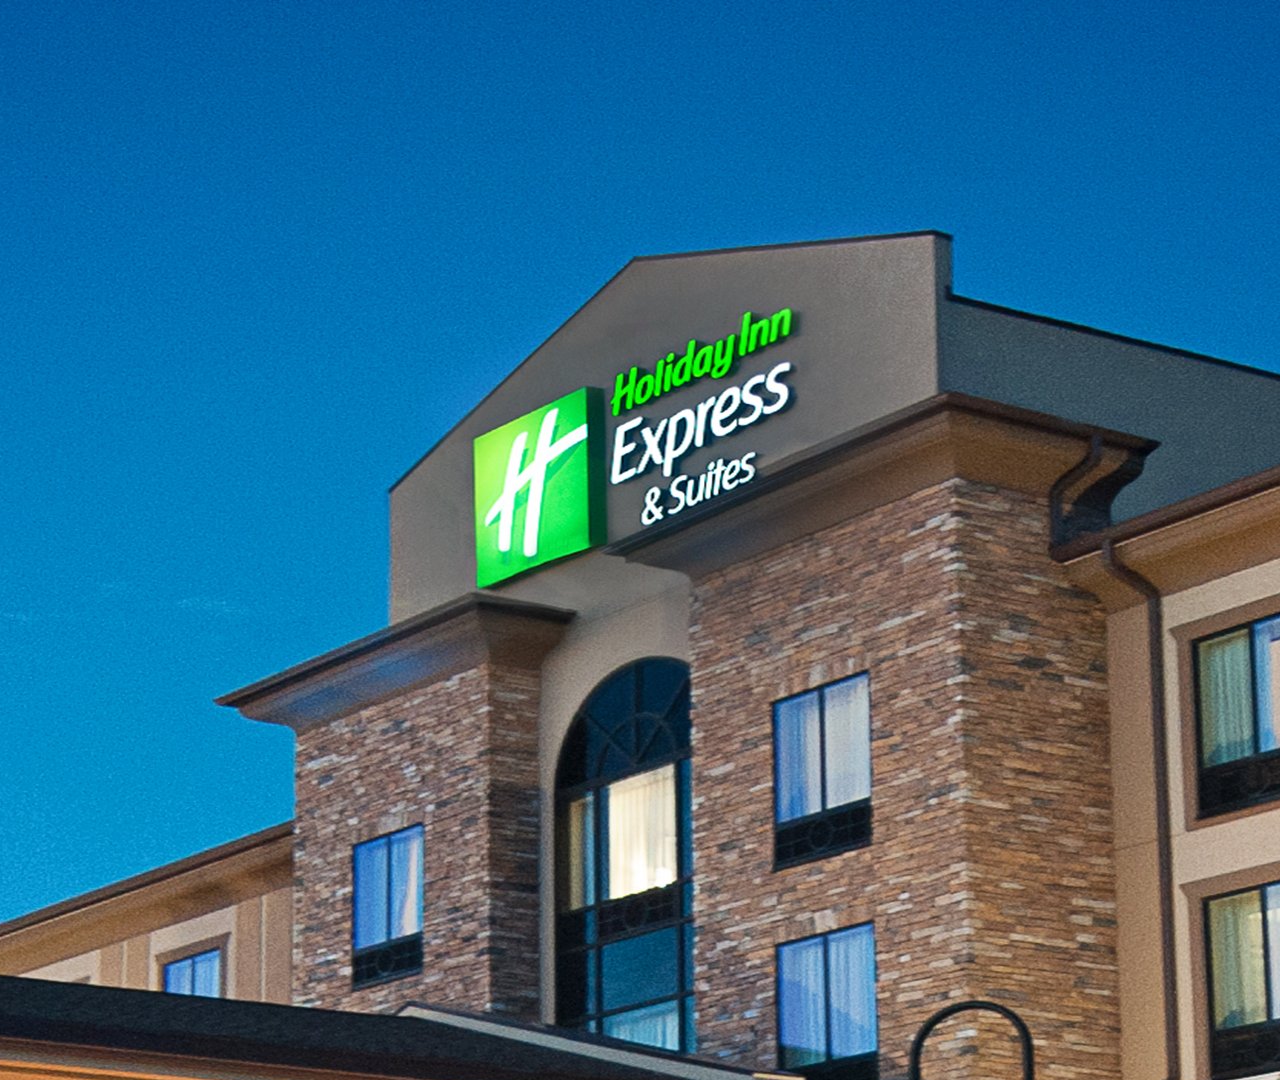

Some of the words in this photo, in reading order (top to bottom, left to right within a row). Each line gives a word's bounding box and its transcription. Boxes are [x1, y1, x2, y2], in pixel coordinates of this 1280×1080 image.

[610, 334, 734, 416] Holiday
[738, 307, 792, 357] Inn
[610, 361, 791, 484] Express
[641, 486, 664, 526] &
[667, 451, 757, 515] Suites
